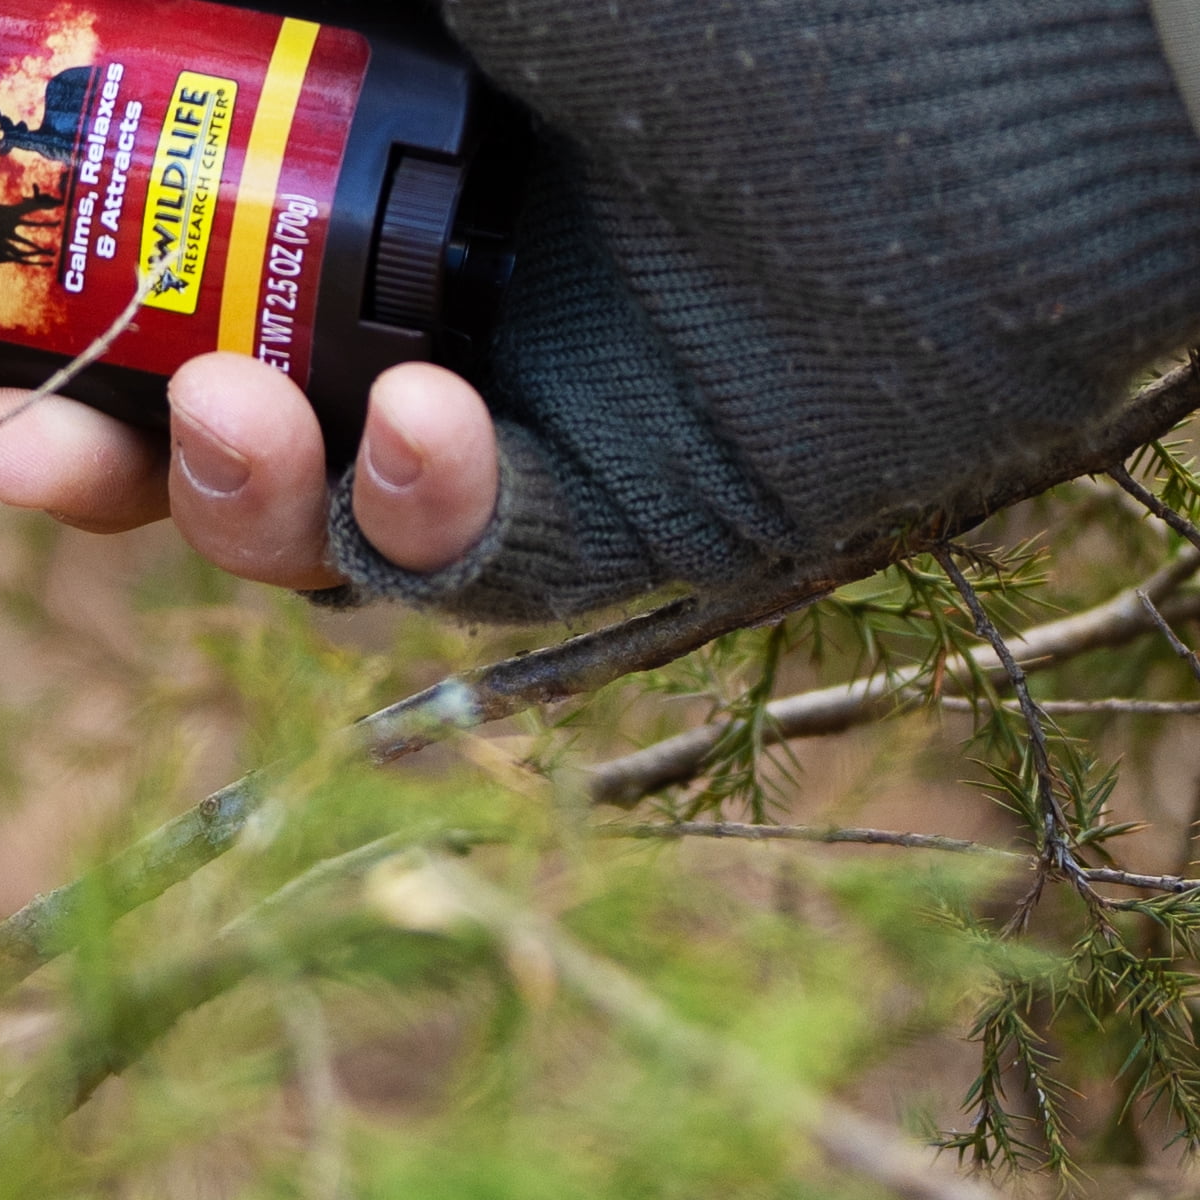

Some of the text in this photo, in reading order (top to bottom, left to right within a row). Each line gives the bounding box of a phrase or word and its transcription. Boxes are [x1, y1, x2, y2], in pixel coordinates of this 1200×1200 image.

[65, 62, 125, 293] Calms, Relaxes
[96, 100, 143, 259] & Attracts
[148, 86, 210, 266] WILDLIFE
[183, 175, 212, 275] RESEARCH
[273, 192, 319, 245] (70g)
[265, 276, 298, 311] 2.5
[268, 243, 304, 276] OZ
[261, 307, 294, 344] WT
